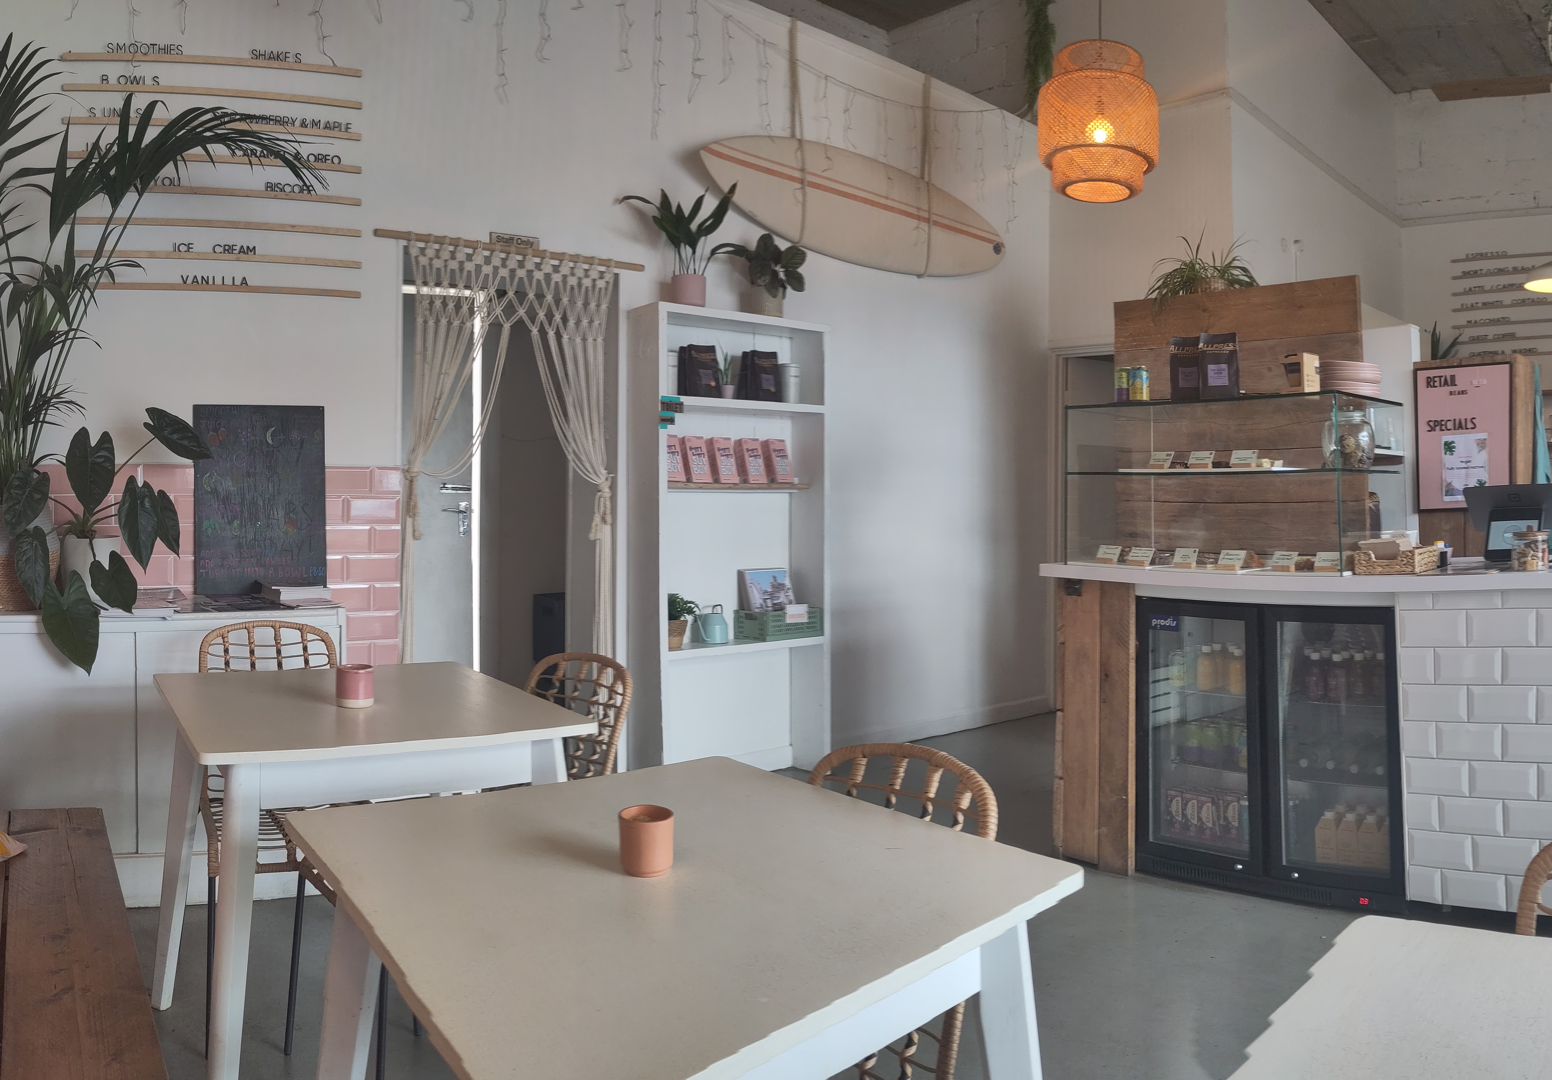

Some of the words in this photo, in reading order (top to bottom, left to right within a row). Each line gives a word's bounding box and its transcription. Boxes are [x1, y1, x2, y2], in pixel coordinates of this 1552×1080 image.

[106, 42, 184, 56] SMOOTHIES
[250, 49, 302, 64] SHAKES
[101, 73, 160, 87] BOWLS
[307, 152, 342, 165] OREO
[172, 242, 194, 253] ICE
[212, 243, 256, 256] CREAM
[1465, 250, 1508, 259] ESPRESSO
[181, 274, 249, 287] VANILLA
[1426, 374, 1458, 389] RETAIL
[1426, 416, 1477, 433] SPECIALS
